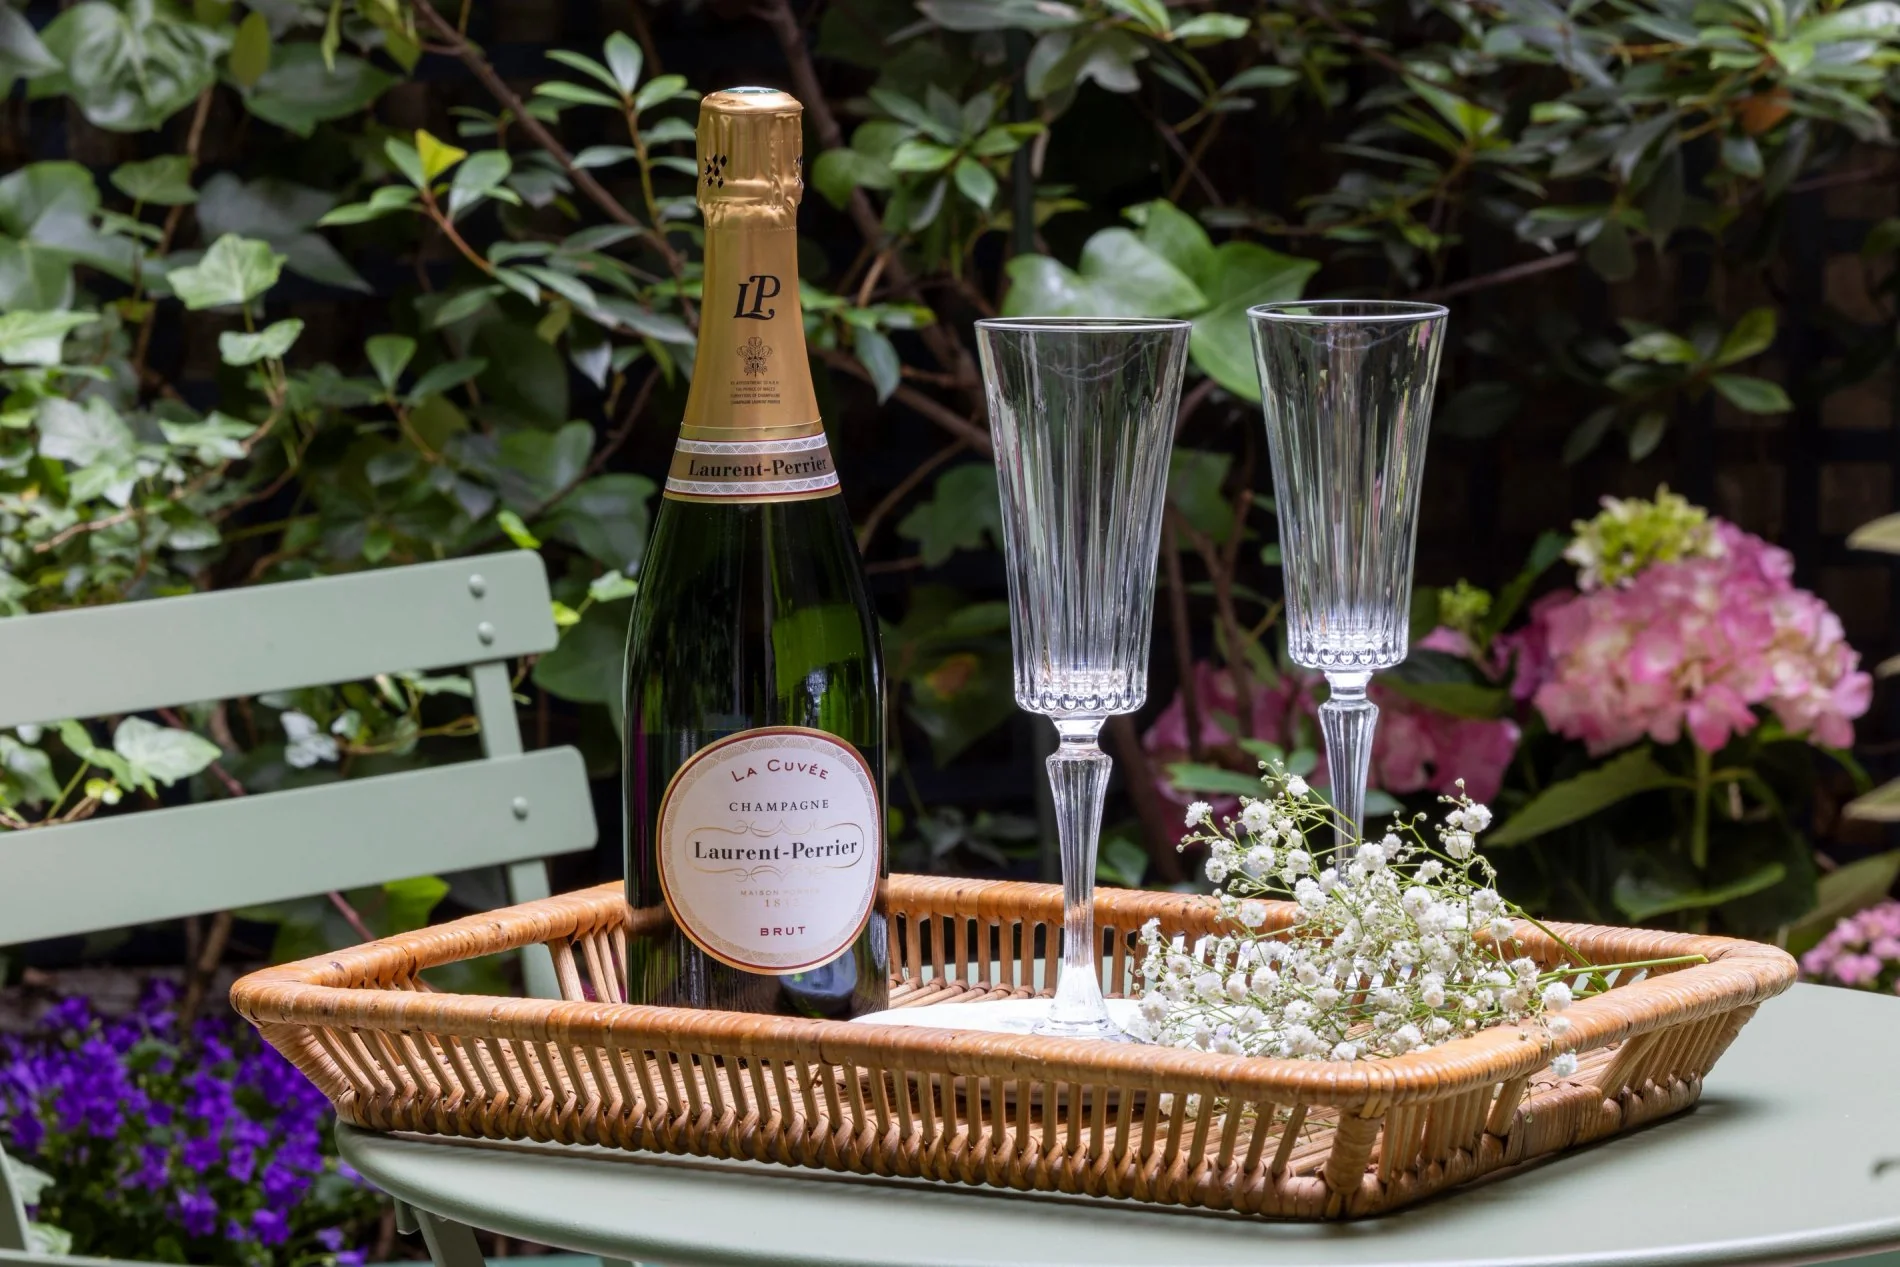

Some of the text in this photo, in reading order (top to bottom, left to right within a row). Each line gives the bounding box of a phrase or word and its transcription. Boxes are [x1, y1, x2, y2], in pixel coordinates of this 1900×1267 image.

[688, 456, 828, 477] Laurent-Perrier
[729, 799, 829, 812] CHAMPAGNE
[695, 839, 858, 861] Laurent-Perrier
[760, 926, 806, 937] BRUT
